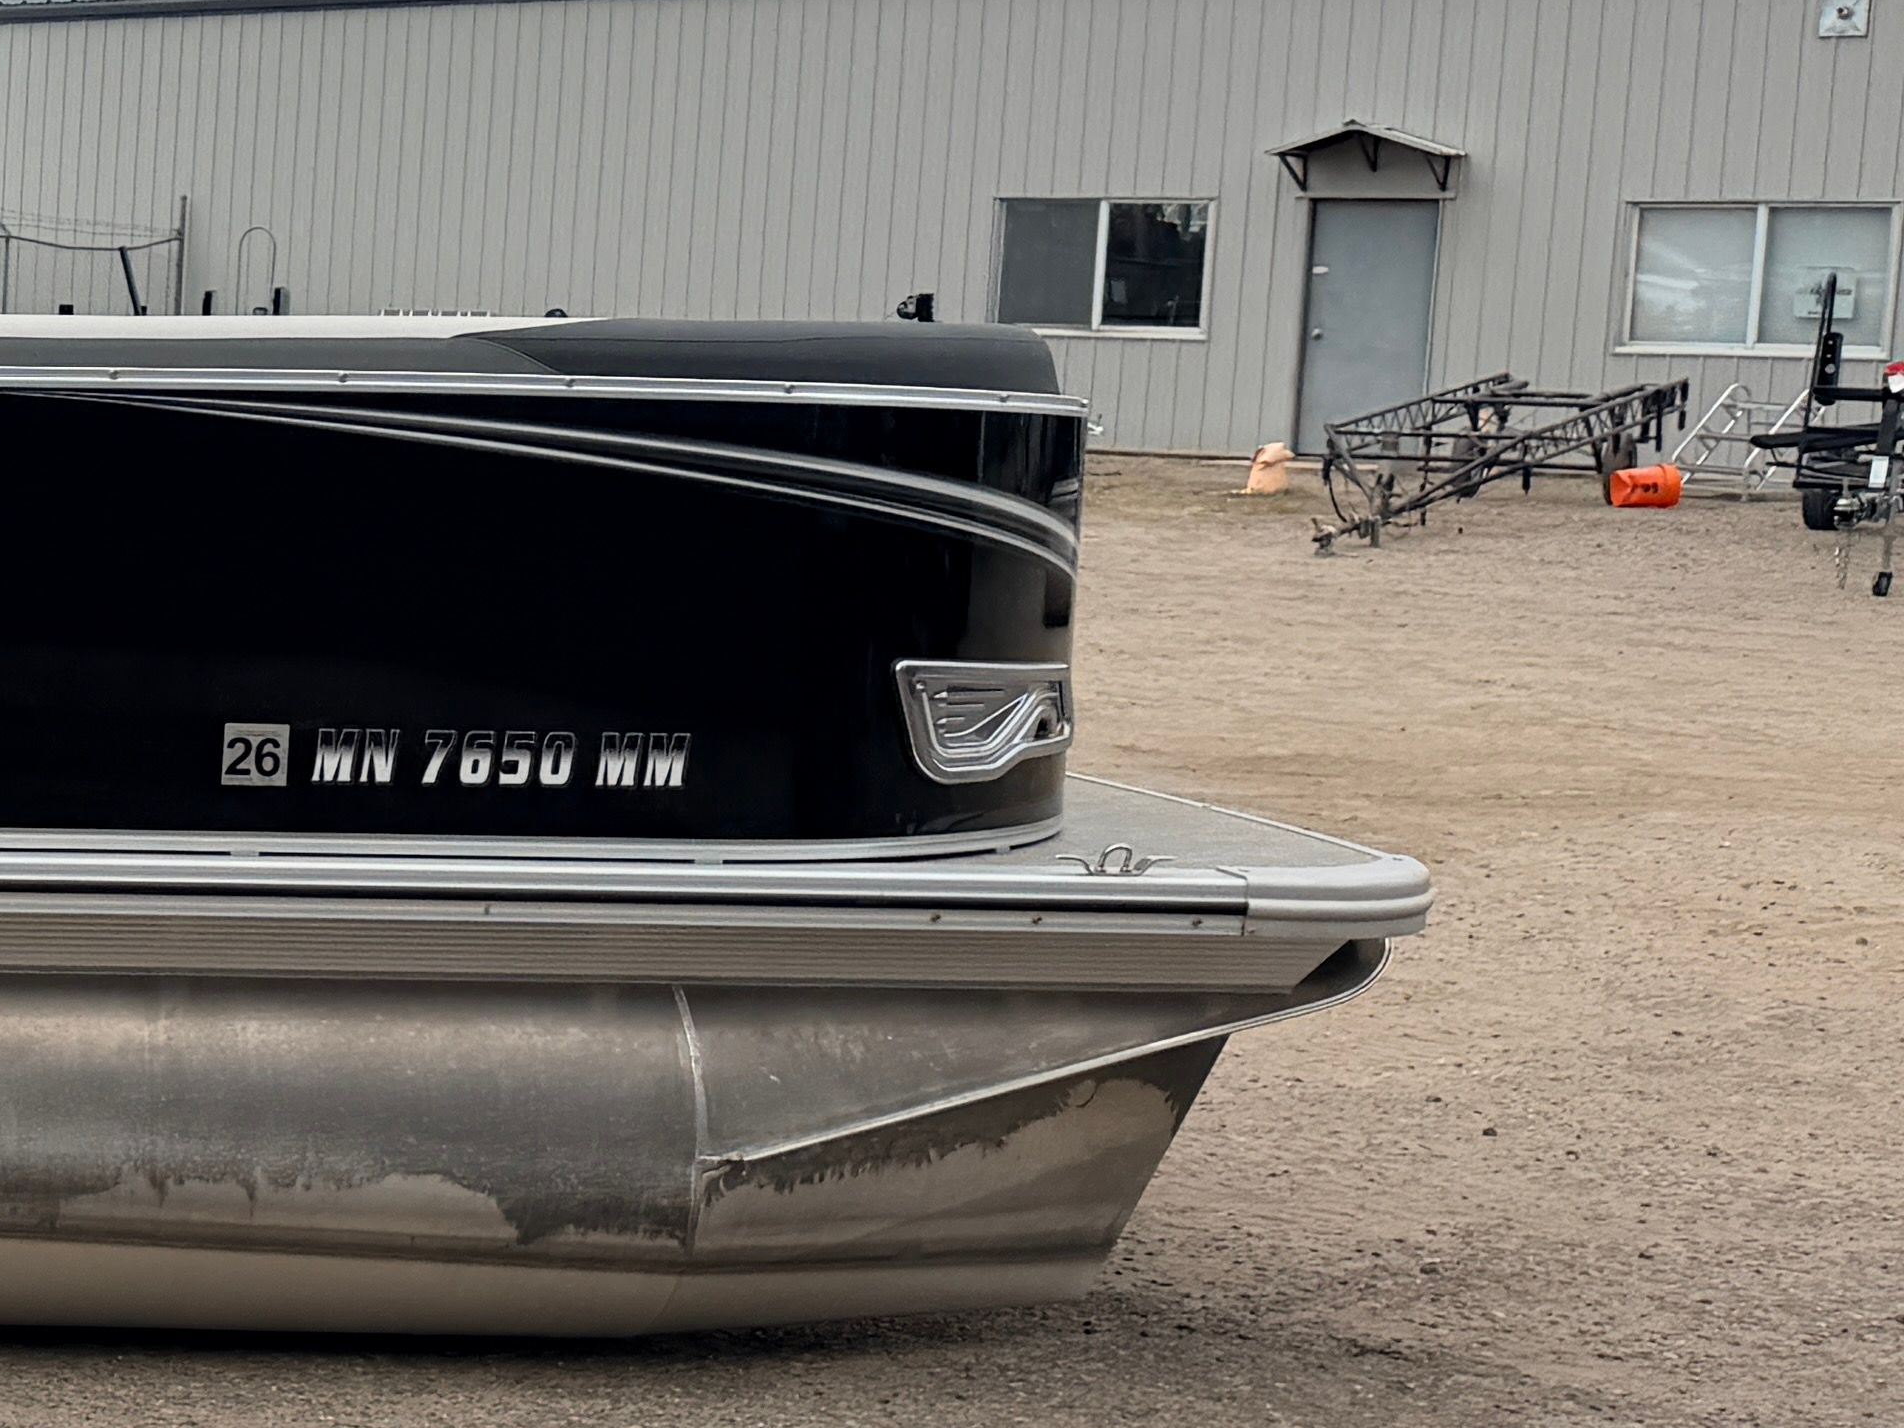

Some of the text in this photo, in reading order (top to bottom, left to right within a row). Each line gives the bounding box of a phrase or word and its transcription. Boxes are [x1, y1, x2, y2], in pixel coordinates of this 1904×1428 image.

[225, 737, 282, 777] 26
[310, 728, 691, 787] MN 7650 MM
